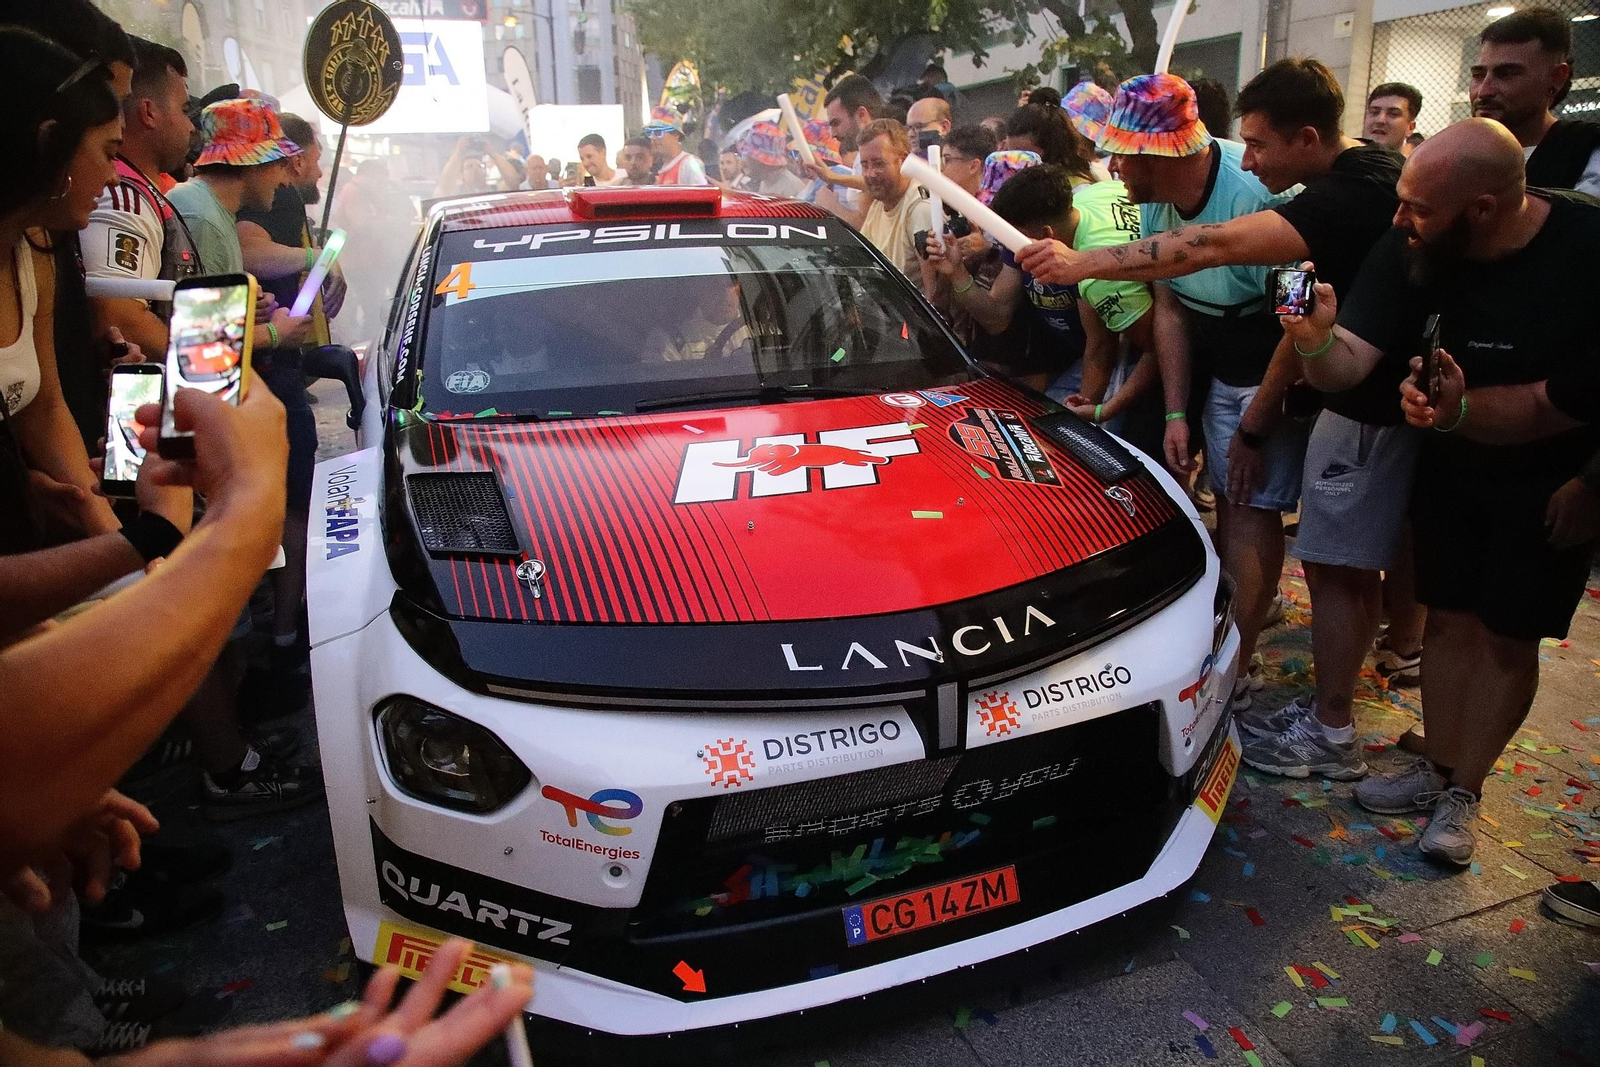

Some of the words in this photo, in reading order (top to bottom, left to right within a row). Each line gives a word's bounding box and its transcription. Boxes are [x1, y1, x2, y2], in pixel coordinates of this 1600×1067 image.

[473, 223, 828, 253] YPSILON
[435, 261, 477, 300] 4
[447, 372, 489, 392] FIA
[952, 422, 1000, 461] 59
[673, 421, 920, 504] HF
[780, 605, 1057, 672] LANCIA
[1022, 665, 1132, 709] DISTRIGO
[1031, 708, 1061, 722] PARTS
[1062, 691, 1122, 714] DISTRIBUTION
[762, 719, 901, 761] DISTRIGO
[767, 762, 804, 775] PARTS
[807, 747, 884, 769] DISTRIBUTION
[1199, 741, 1238, 813] PIRELLI
[539, 830, 640, 860] TotalEnergies
[381, 859, 573, 946] QUARTZ
[853, 927, 861, 939] P
